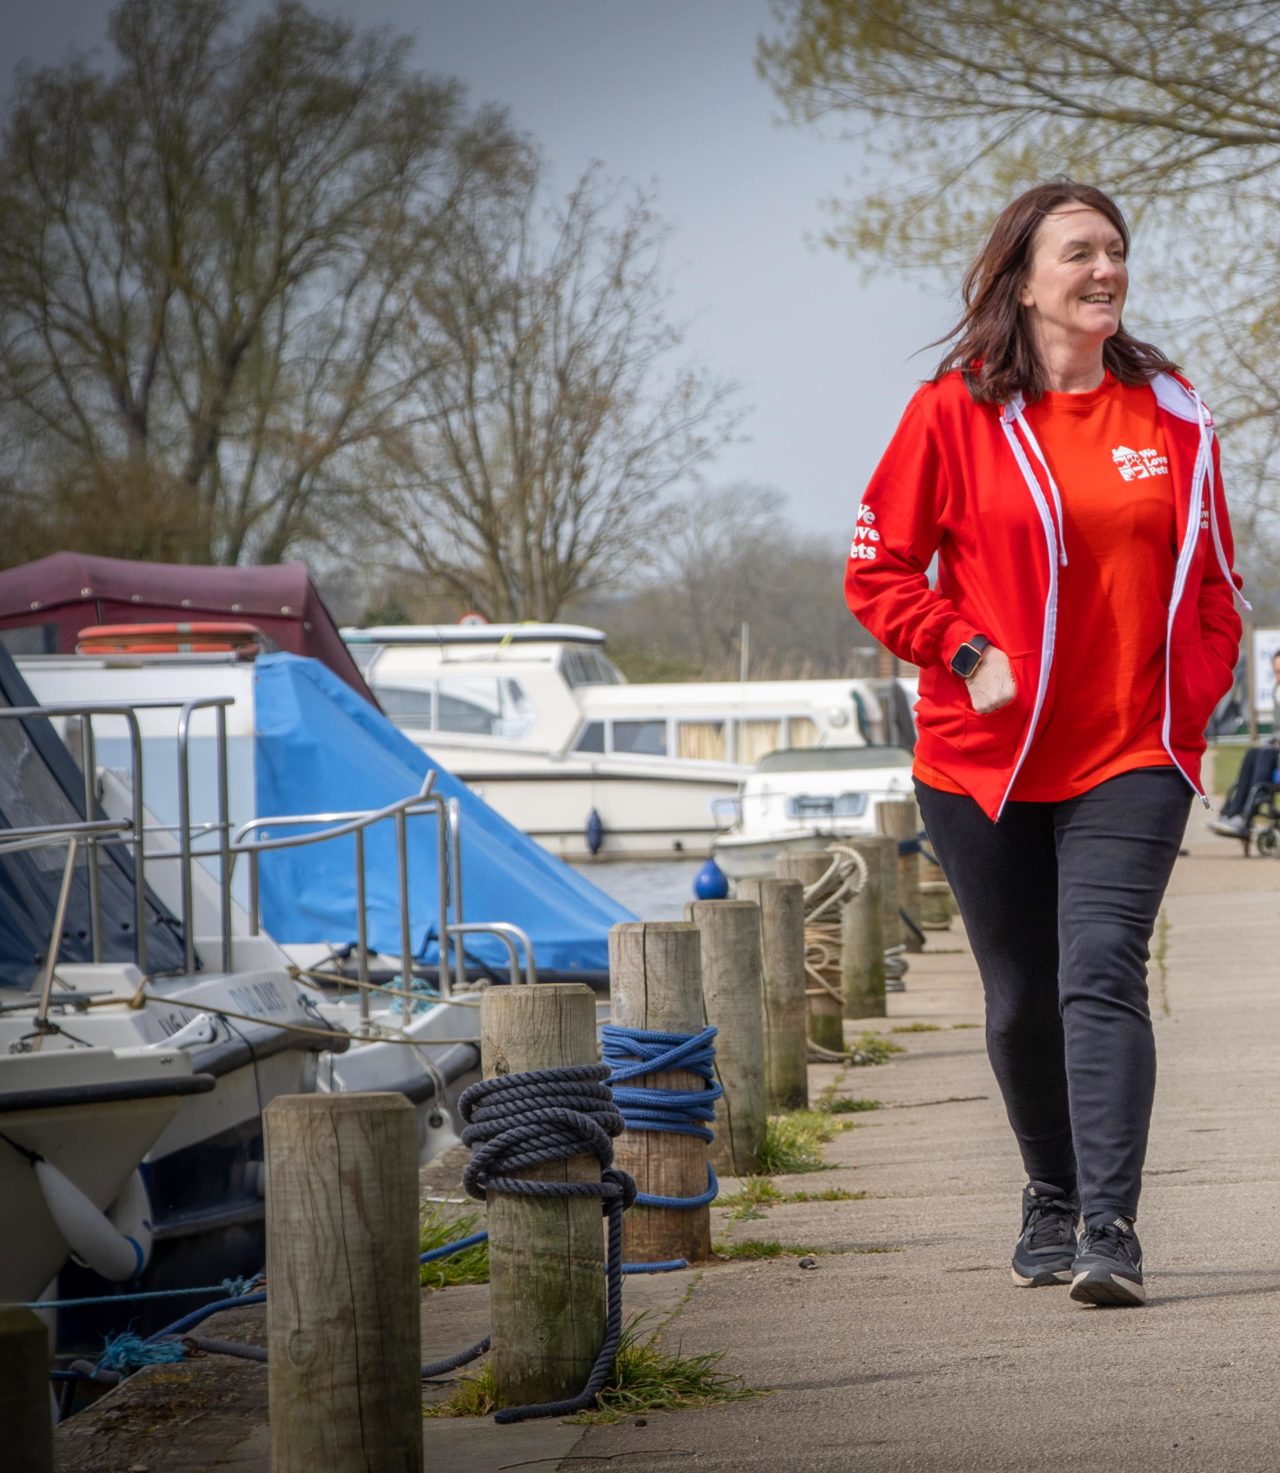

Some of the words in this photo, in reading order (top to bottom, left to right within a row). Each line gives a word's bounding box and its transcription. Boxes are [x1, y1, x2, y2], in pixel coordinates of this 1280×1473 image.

[1138, 448, 1157, 458] We
[1143, 456, 1168, 466] Love
[854, 525, 880, 541] ve
[850, 541, 876, 560] ets
[1113, 1218, 1129, 1233] NIKE
